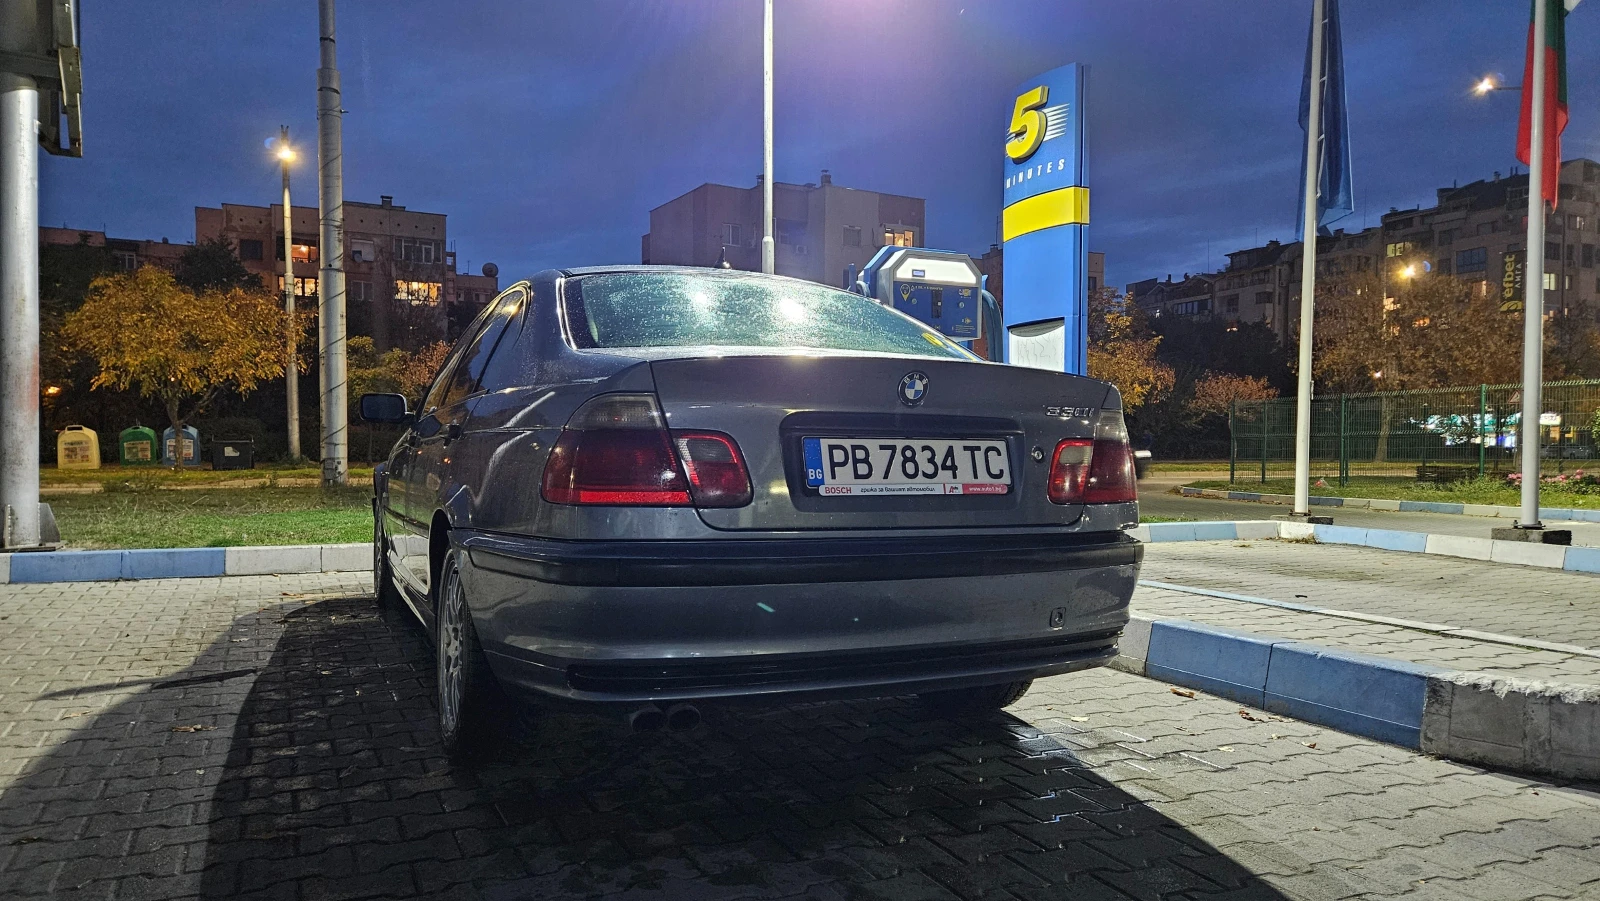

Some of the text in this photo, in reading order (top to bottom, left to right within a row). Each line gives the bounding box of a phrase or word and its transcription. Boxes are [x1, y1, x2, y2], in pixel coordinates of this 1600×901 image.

[1005, 85, 1049, 159] 5
[1006, 158, 1066, 189] MINUTES
[1502, 254, 1516, 299] efbet
[808, 468, 823, 480] BG
[827, 444, 1005, 480] PB 7834 TC
[824, 486, 852, 495] BOSCH
